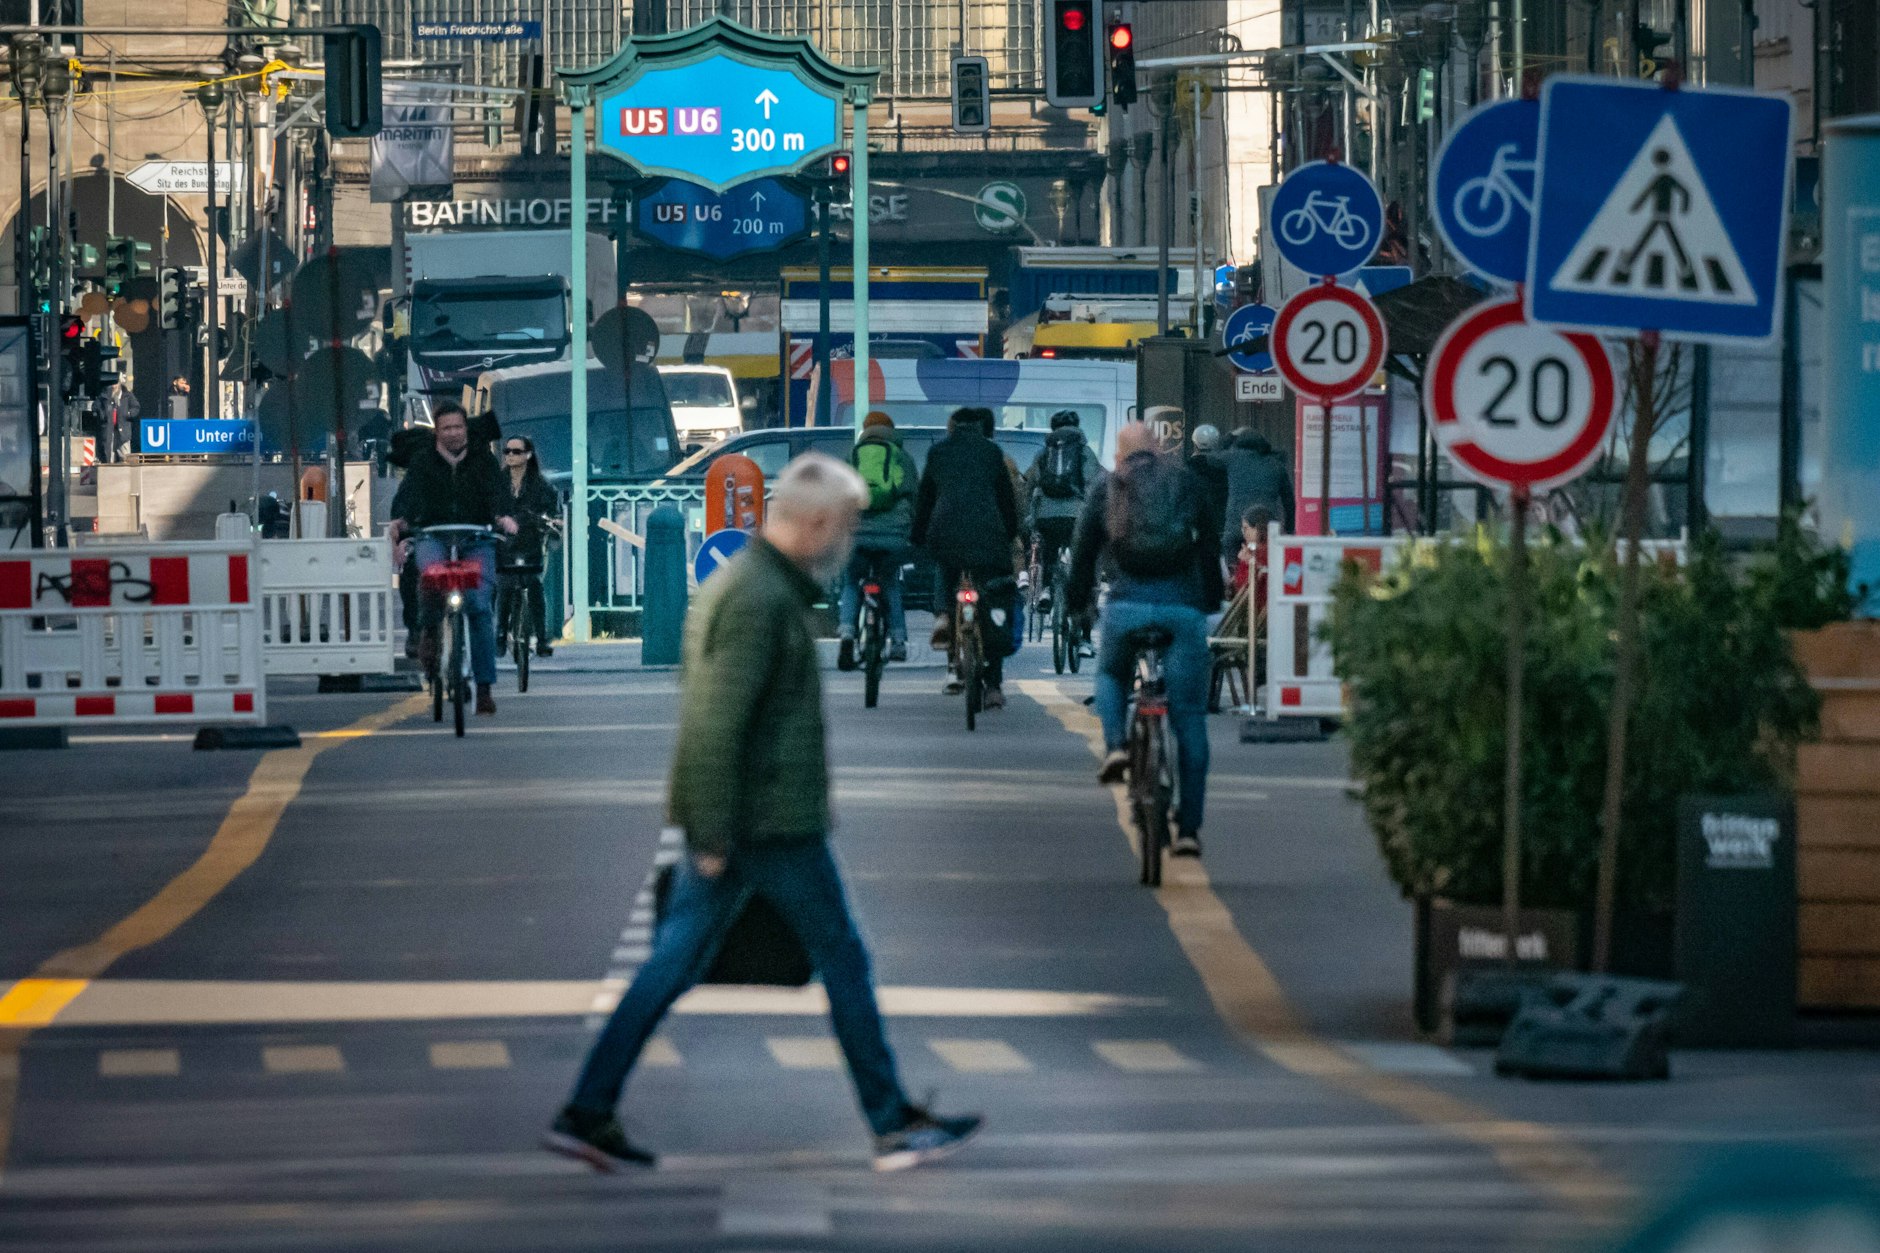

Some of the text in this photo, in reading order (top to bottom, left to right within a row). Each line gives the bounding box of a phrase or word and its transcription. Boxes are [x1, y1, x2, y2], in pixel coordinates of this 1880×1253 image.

[418, 25, 447, 36] Berlin
[625, 109, 718, 133] U5 U6
[380, 127, 441, 140] MARITIM
[731, 128, 804, 151] 300 m
[157, 180, 171, 189] Sitz
[175, 180, 188, 188] des
[656, 205, 722, 221] U5 U6
[733, 218, 784, 234] 200 m
[1302, 320, 1357, 365] 20
[1242, 381, 1277, 394] Ende
[1479, 356, 1571, 428] 20
[147, 425, 165, 447] U
[195, 429, 234, 442] Unter
